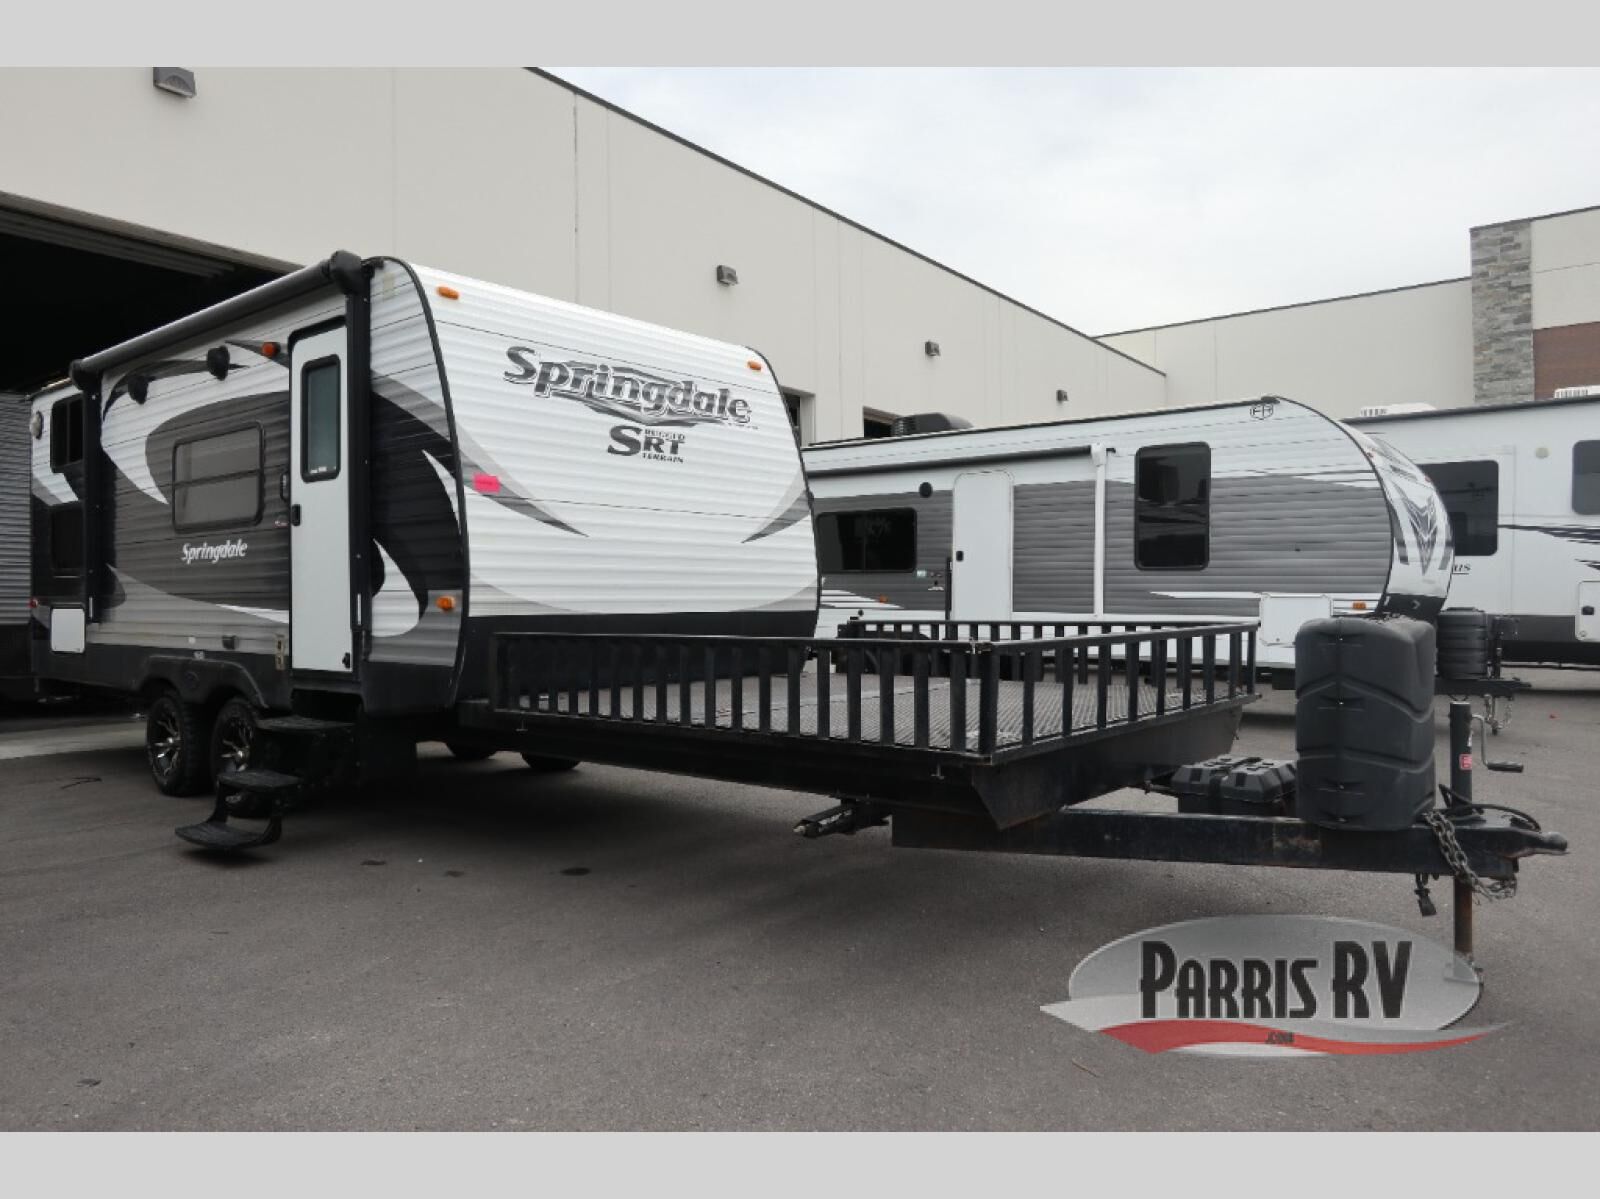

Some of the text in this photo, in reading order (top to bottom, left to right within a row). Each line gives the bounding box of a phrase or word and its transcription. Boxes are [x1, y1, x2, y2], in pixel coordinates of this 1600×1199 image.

[504, 345, 751, 423] Springdale
[607, 425, 686, 456] SRT
[181, 538, 248, 565] Springdale
